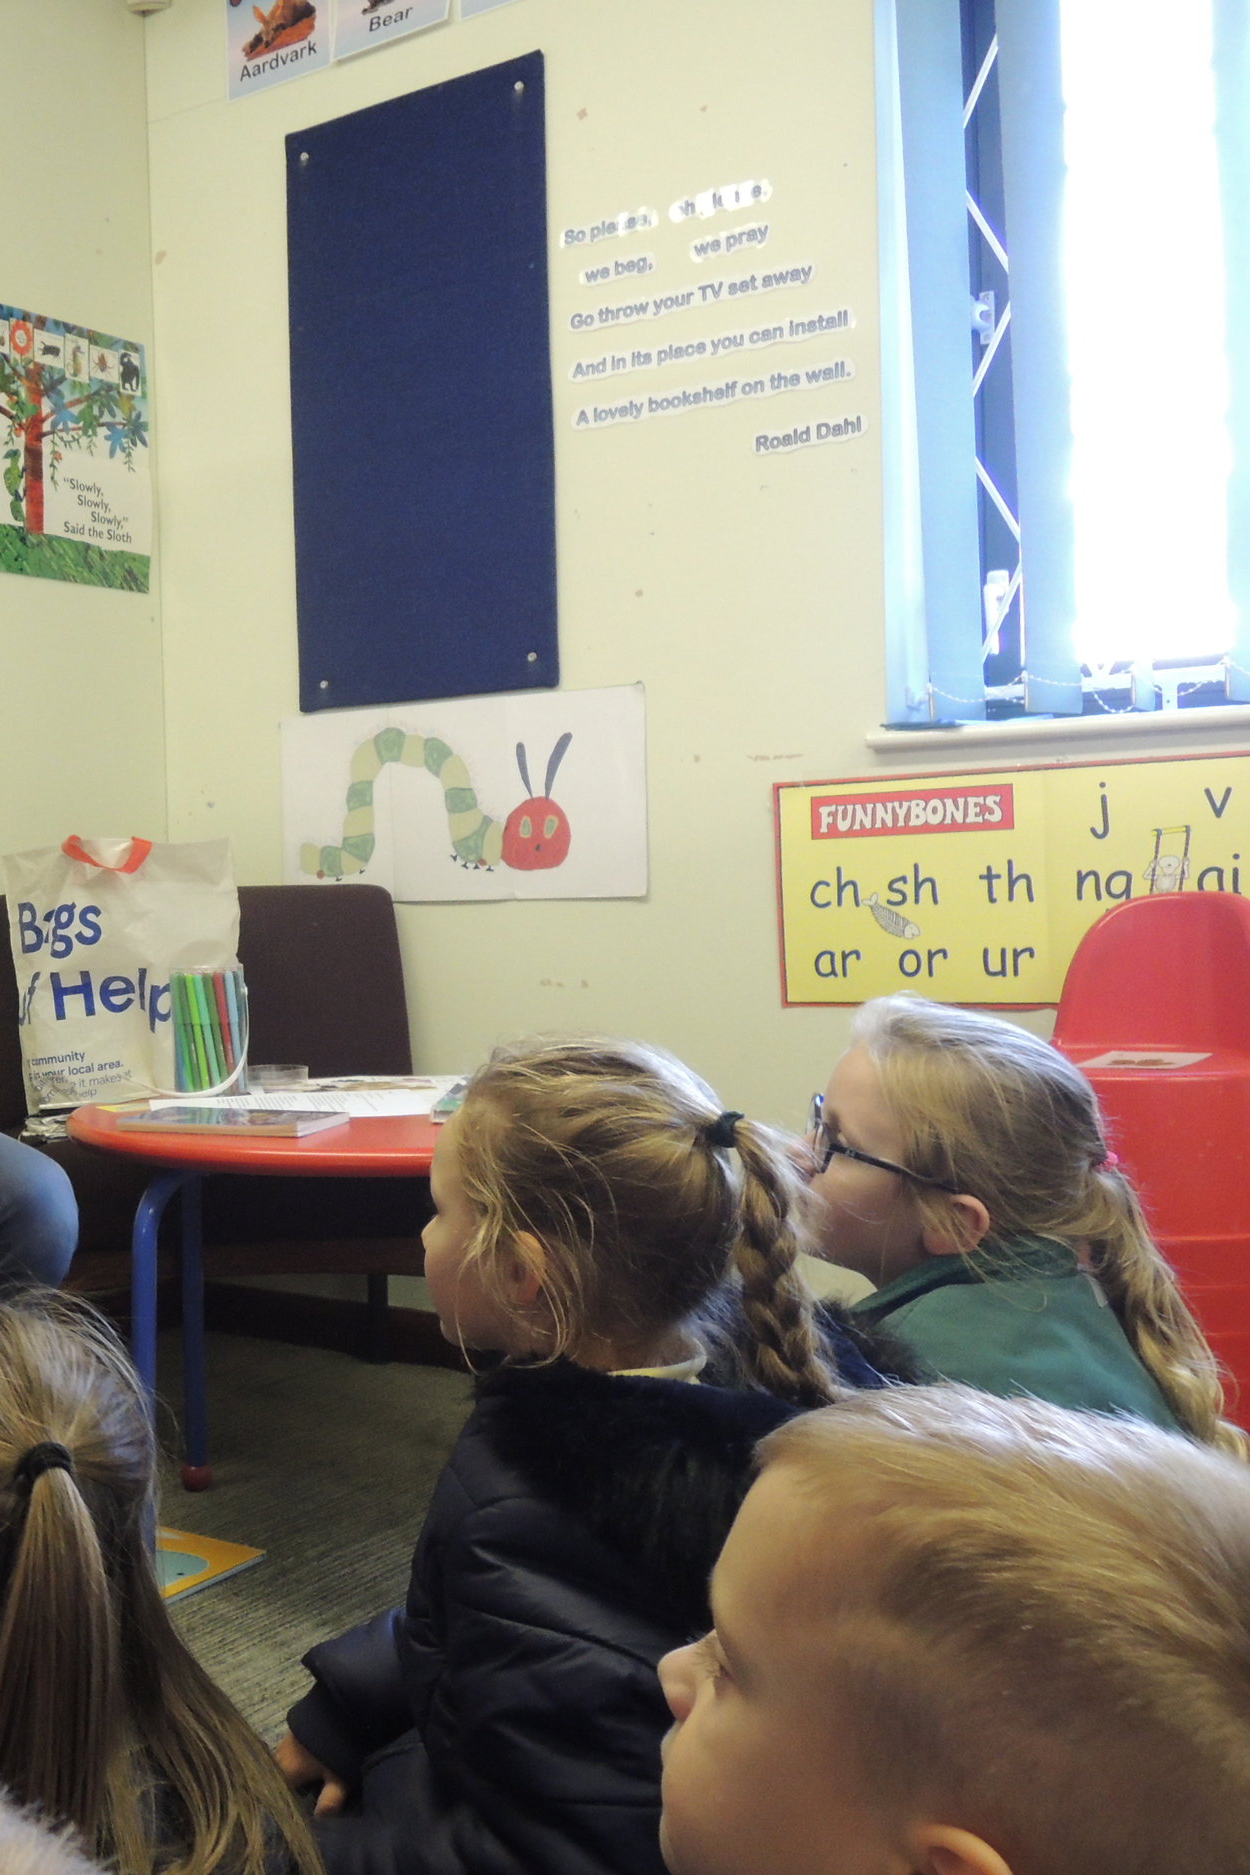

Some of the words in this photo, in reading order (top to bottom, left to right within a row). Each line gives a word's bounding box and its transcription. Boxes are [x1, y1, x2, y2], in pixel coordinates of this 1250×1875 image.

[368, 6, 413, 32] Bear
[240, 40, 318, 82] Aardvark
[564, 229, 586, 245] So
[590, 213, 652, 243] plese,
[585, 266, 610, 283] we
[614, 257, 654, 277] beg,
[694, 239, 721, 257] we
[725, 224, 769, 252] pray
[570, 312, 594, 330] Go
[598, 301, 649, 323] throw
[653, 291, 694, 316] your
[699, 282, 723, 301] TV
[728, 275, 758, 296] set
[762, 264, 813, 288] away
[572, 358, 607, 379] And
[611, 354, 627, 370] in
[631, 350, 652, 368] its
[657, 338, 706, 366] place
[710, 333, 744, 356] you
[748, 326, 785, 344] can
[789, 309, 849, 336] install
[576, 409, 590, 426] A
[593, 399, 644, 423] lovely
[649, 381, 737, 412] bookshelf
[741, 378, 765, 395] on
[770, 370, 801, 390] the
[805, 360, 852, 384] wall.
[755, 427, 811, 452] Roald
[817, 416, 862, 440] Dahl
[77, 494, 111, 514] Slowly,
[64, 520, 85, 536] Said
[88, 526, 104, 539] the
[106, 528, 132, 543] Sloth
[818, 794, 1004, 834] FUNNYBONES
[1089, 781, 1110, 840] j
[1204, 786, 1232, 819] v
[810, 866, 861, 909] ch
[886, 862, 939, 906] sh
[979, 859, 1035, 903] th
[814, 949, 862, 978] ar
[899, 946, 948, 978] or
[983, 946, 1035, 978] ur
[49, 967, 174, 1034] Help
[68, 1063, 95, 1076] local
[97, 1060, 124, 1072] area.
